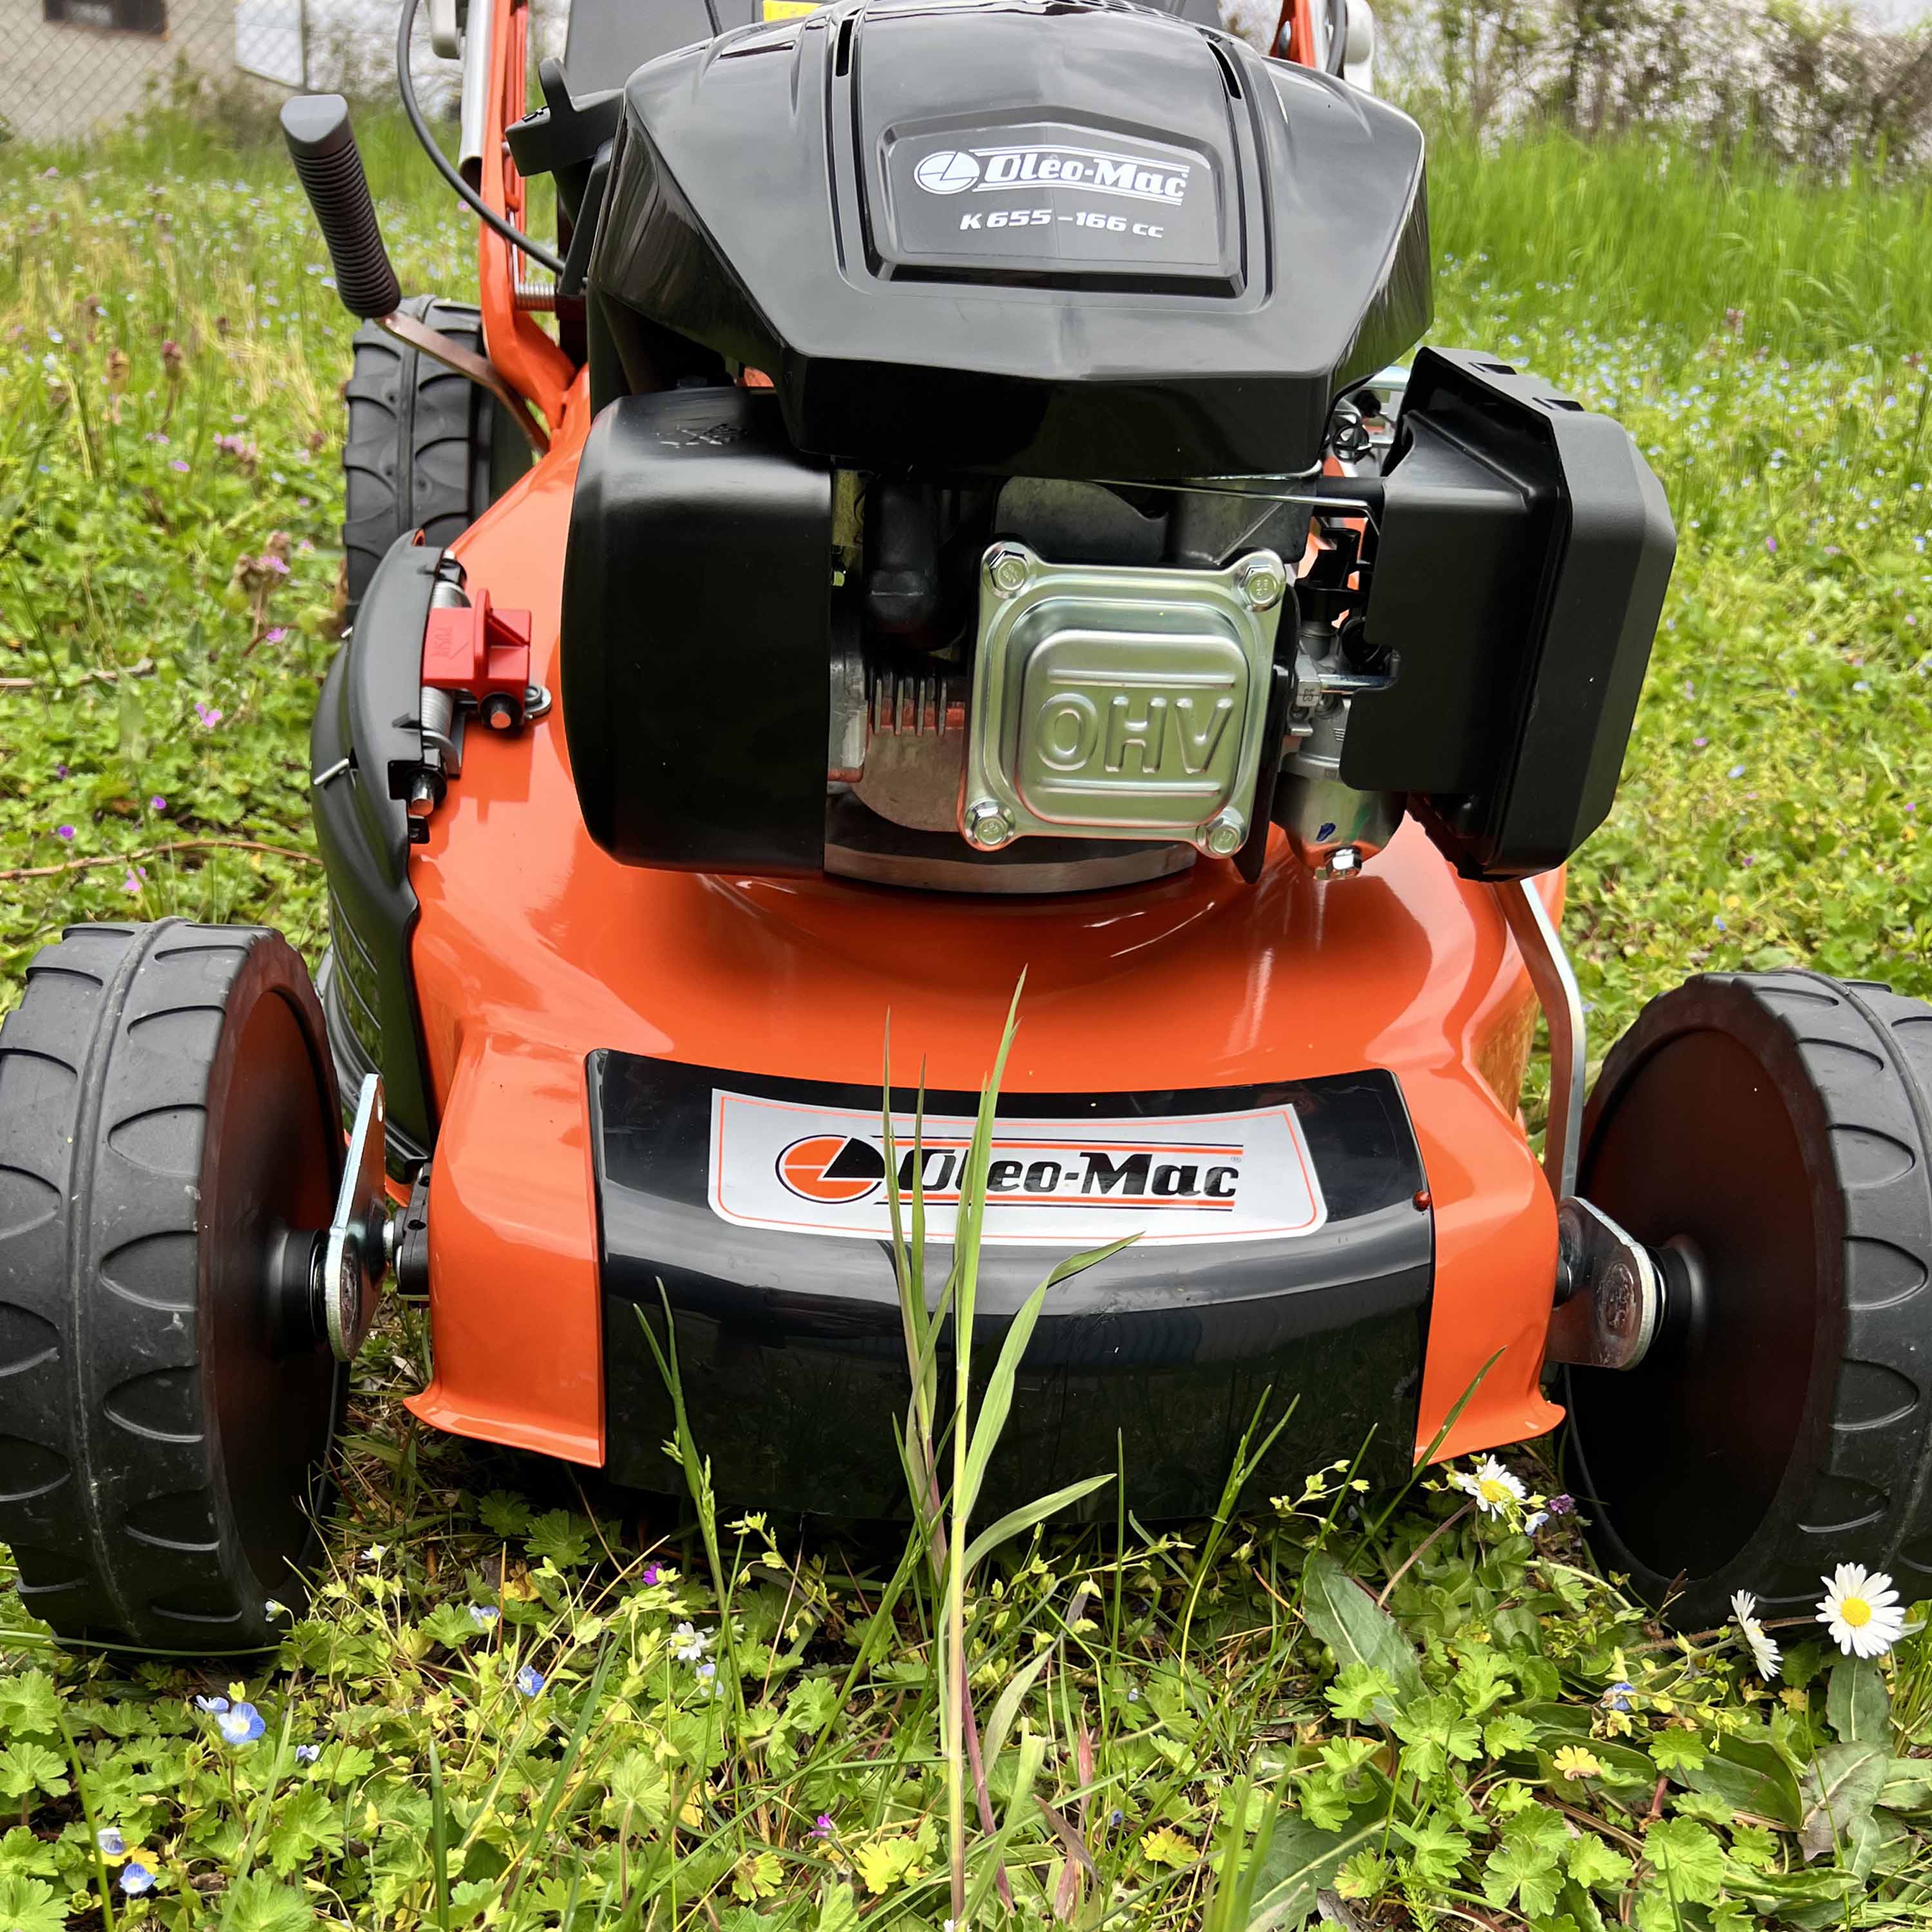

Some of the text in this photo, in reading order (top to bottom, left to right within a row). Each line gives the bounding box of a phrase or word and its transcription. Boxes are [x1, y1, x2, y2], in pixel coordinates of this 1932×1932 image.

[984, 153, 1187, 198] Oleo-Mac
[959, 213, 983, 231] K
[1132, 223, 1164, 238] cc
[1036, 692, 1234, 773] OHV
